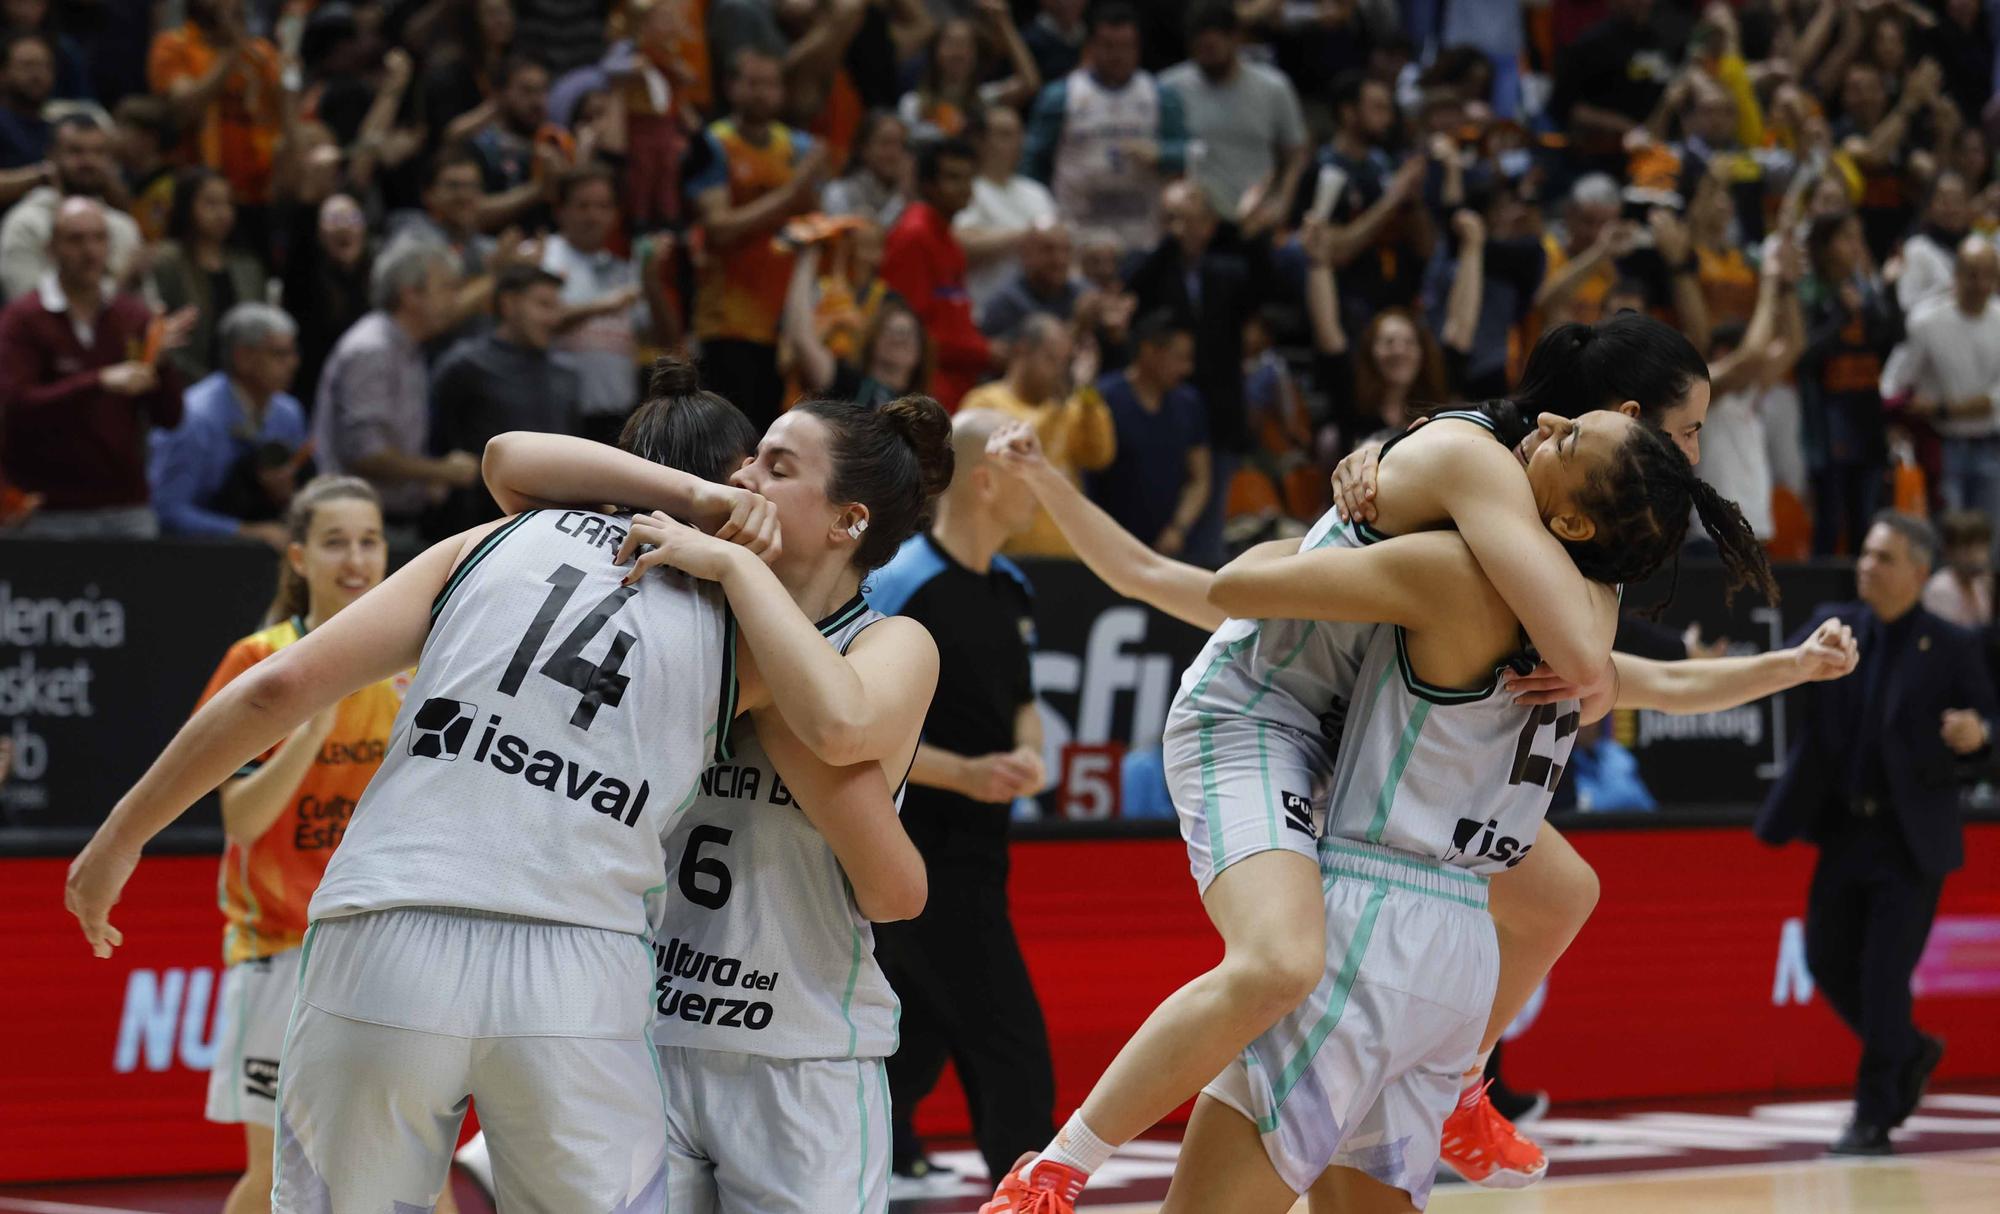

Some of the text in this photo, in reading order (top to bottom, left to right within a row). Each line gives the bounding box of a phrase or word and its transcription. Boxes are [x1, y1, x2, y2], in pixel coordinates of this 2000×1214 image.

[496, 563, 640, 732] 14
[473, 713, 650, 828] isaval
[1065, 754, 1114, 822] 5
[678, 824, 733, 910] 6
[741, 970, 779, 991] del
